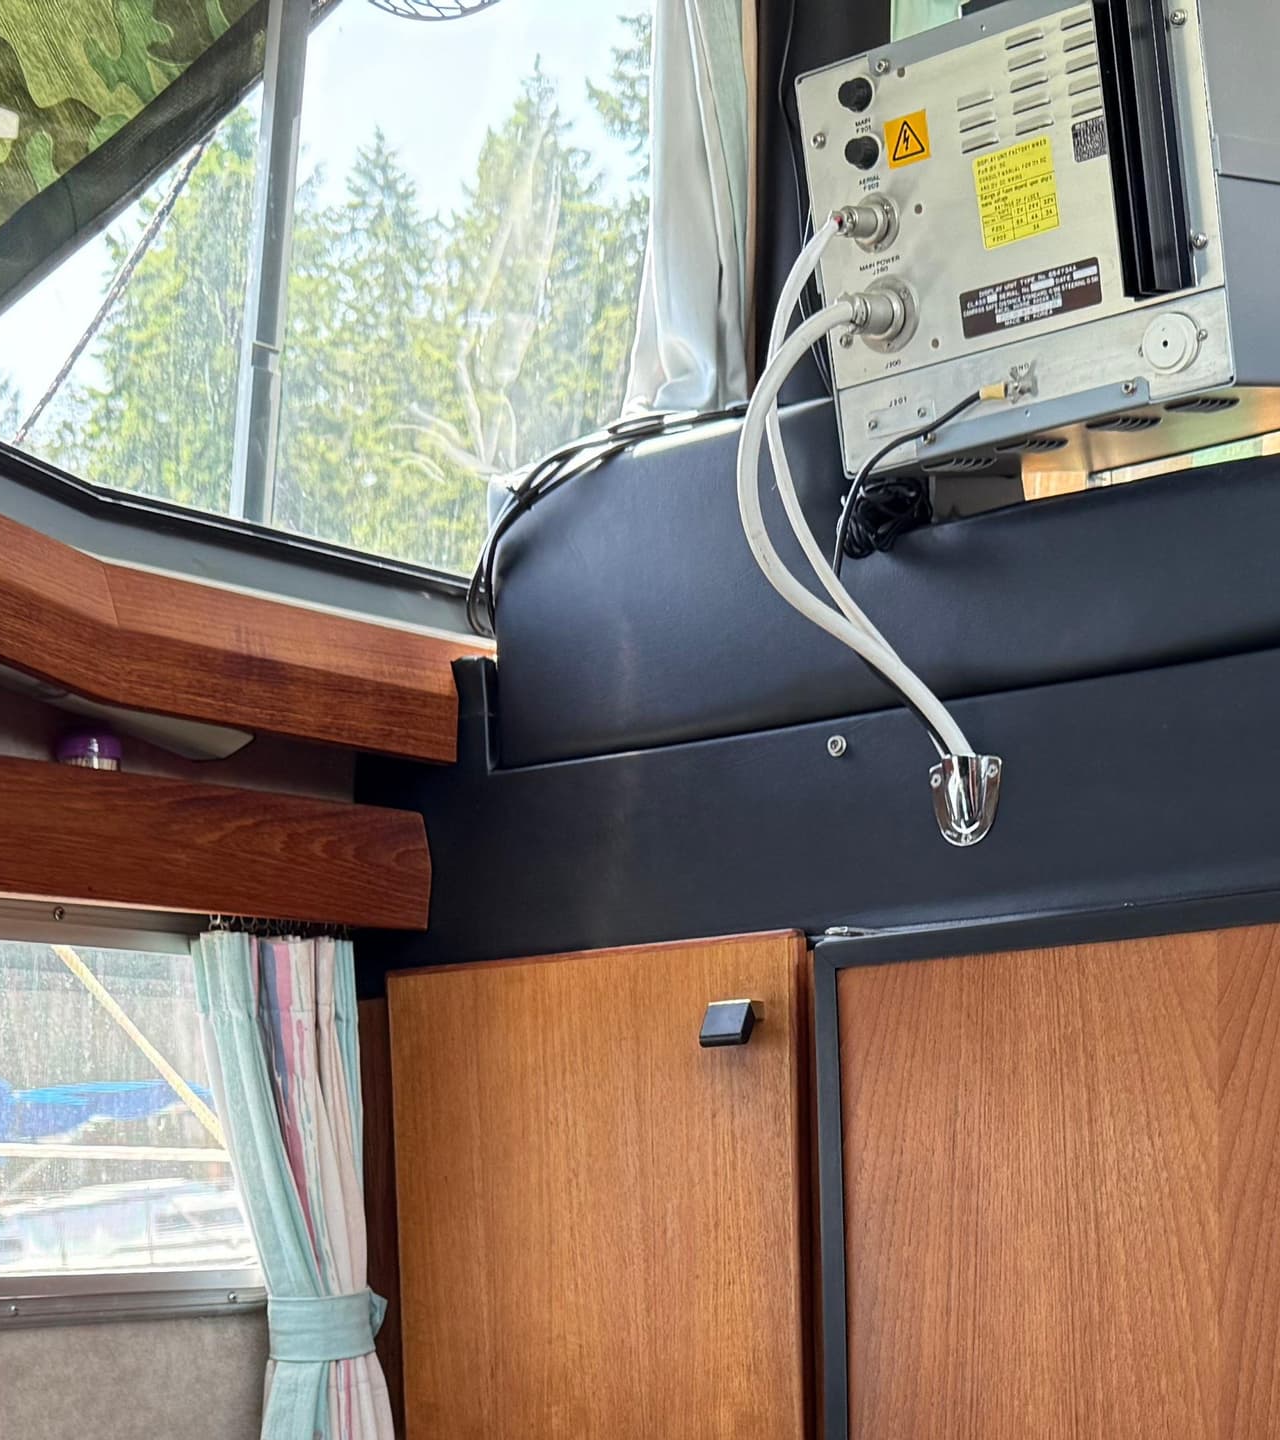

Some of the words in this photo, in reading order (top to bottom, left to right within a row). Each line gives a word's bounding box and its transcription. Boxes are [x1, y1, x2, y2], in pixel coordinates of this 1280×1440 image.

[859, 262, 875, 271] MAIN
[876, 254, 900, 266] POWER
[967, 297, 987, 309] CLASS
[1000, 290, 1020, 301] SERIAL
[1055, 275, 1072, 285] DATE
[1061, 279, 1086, 291] STEERING
